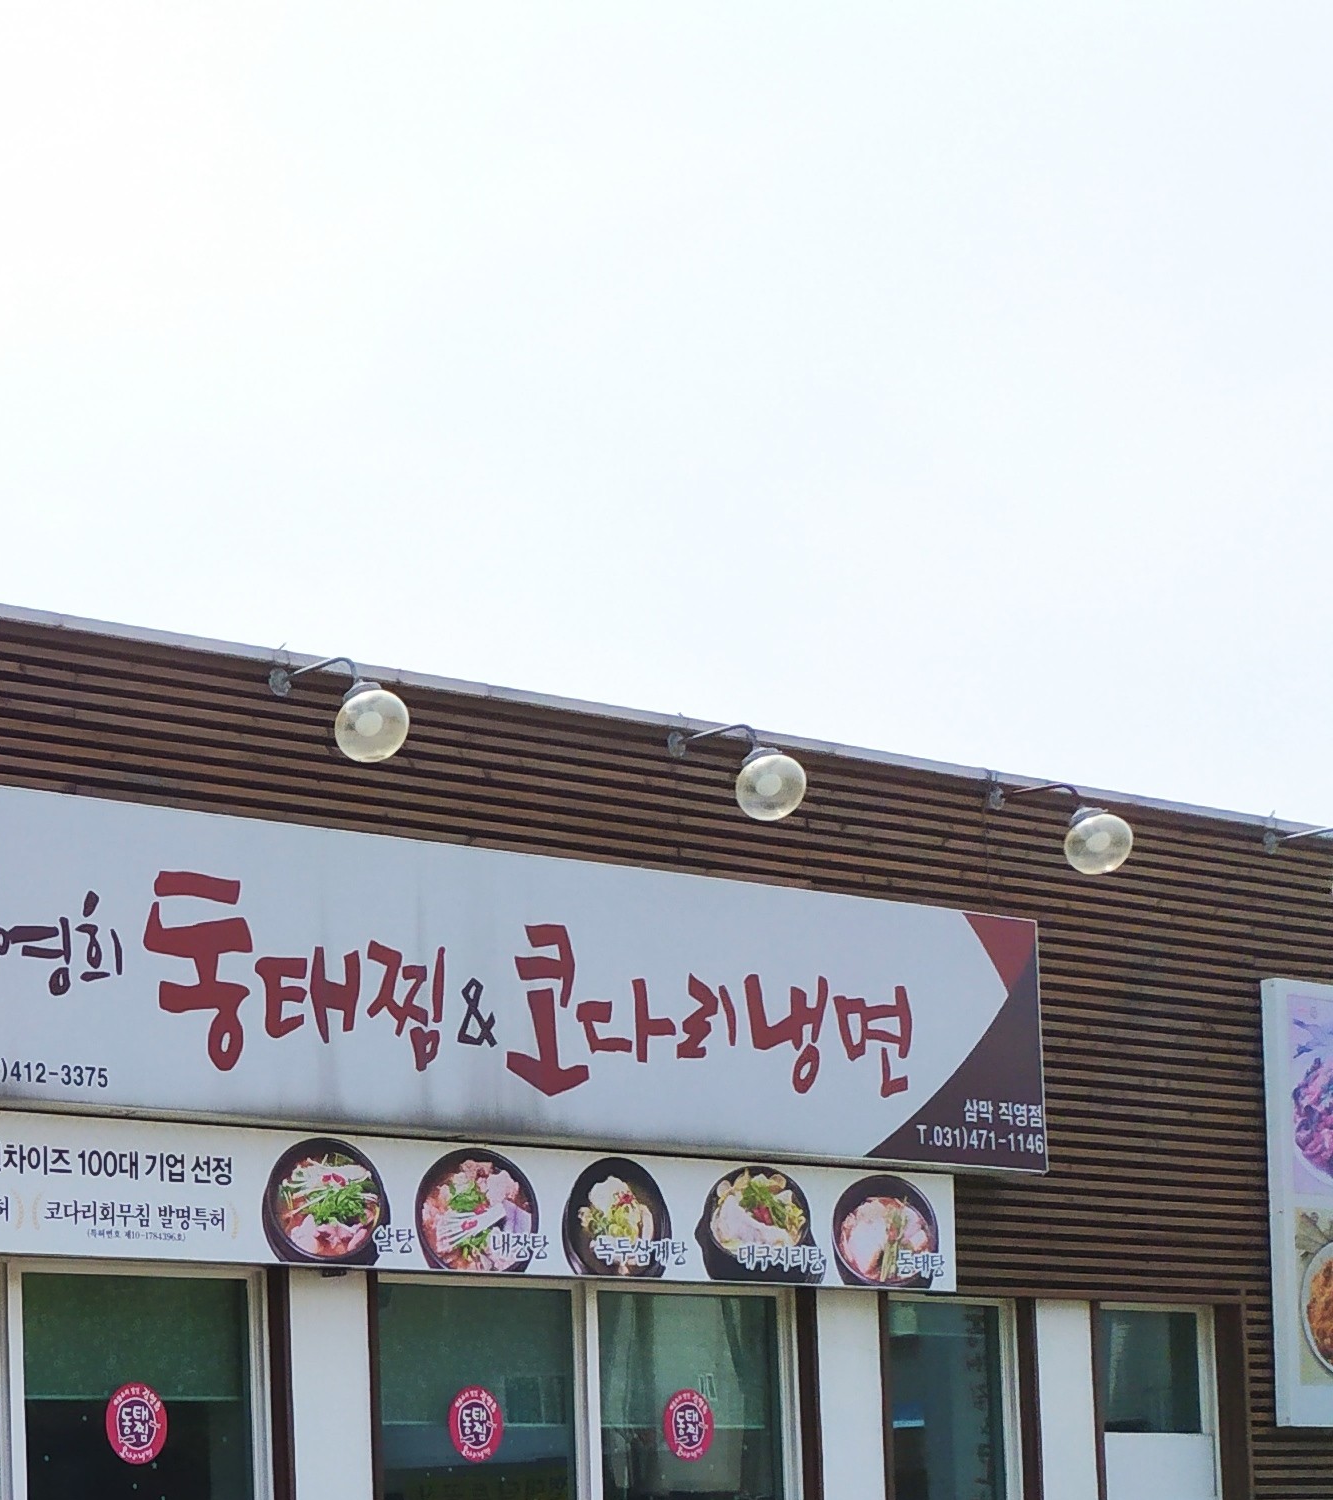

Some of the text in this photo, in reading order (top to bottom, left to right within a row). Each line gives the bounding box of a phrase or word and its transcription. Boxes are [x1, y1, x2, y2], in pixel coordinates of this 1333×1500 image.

[963, 1098, 1043, 1128] 삼막 직영점
[77, 1149, 139, 1181] 100대
[144, 1152, 186, 1184] 기업
[190, 1155, 233, 1186] 선정
[44, 1199, 226, 1232] 코다리회무침 발명특허
[374, 1224, 415, 1255] 알탕
[491, 1232, 550, 1260] 내장탕
[595, 1237, 689, 1266] 녹두삼계탕
[737, 1244, 825, 1272] 대구지리탕
[896, 1251, 946, 1278] 동태탕
